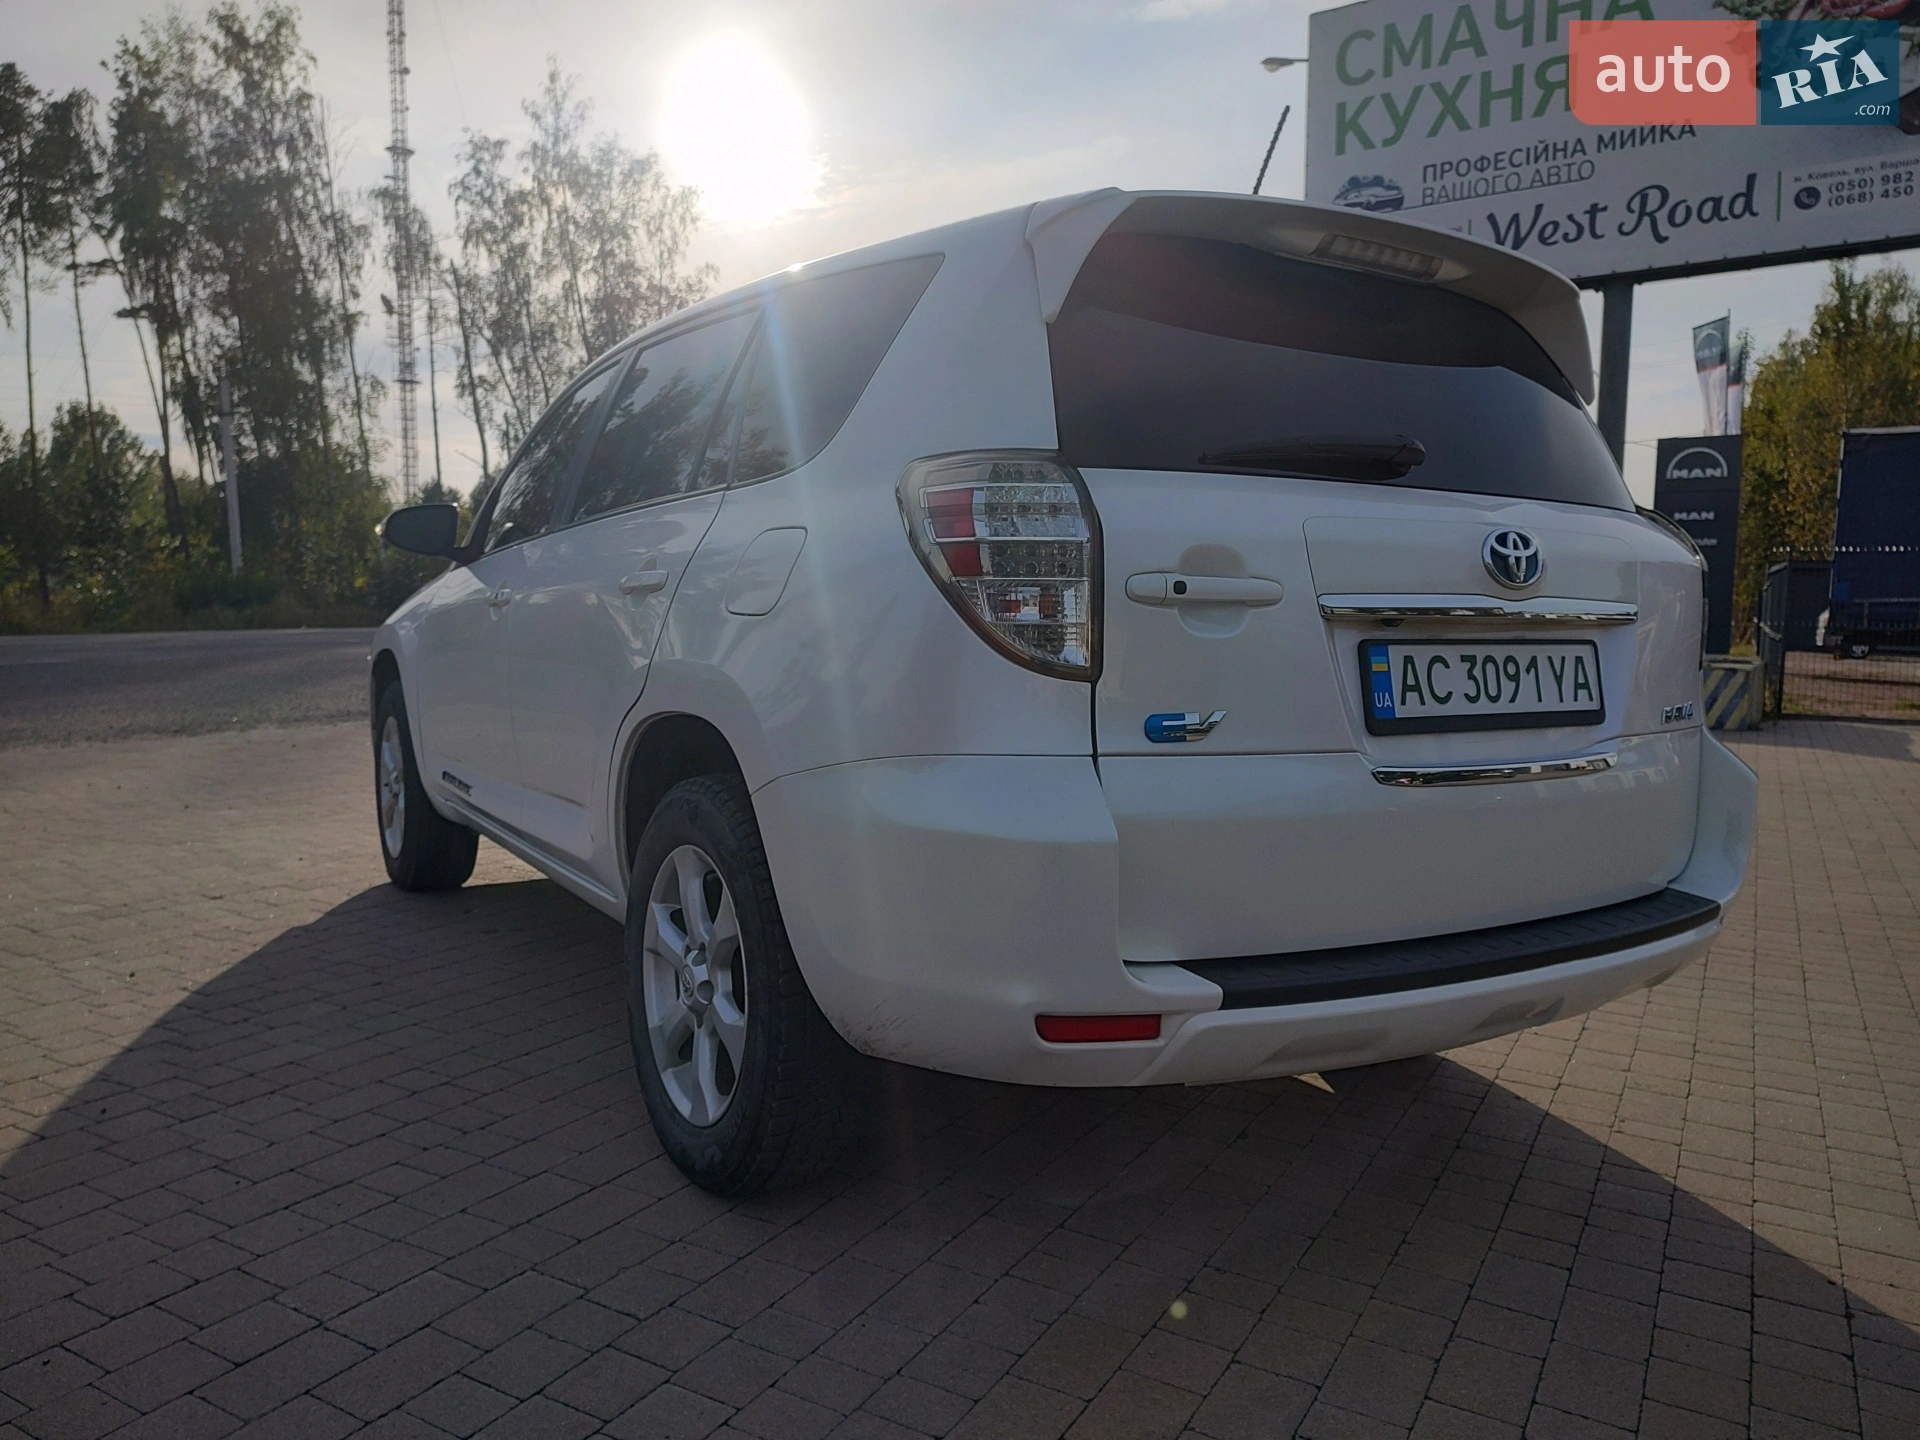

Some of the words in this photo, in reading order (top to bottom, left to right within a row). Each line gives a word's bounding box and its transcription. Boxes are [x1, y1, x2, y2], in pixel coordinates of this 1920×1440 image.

[1334, 53, 1578, 156] КУХНЯ
[1422, 137, 1587, 184] ПРОФЕСІЙНА
[1421, 171, 1522, 205] ВАШОГО
[1529, 159, 1596, 189] АВТО
[1828, 177, 1875, 195] (050)
[1881, 170, 1915, 186] 982
[1828, 191, 1875, 208] (068)
[1881, 184, 1915, 199] 450
[1486, 203, 1608, 250] West
[1617, 173, 1756, 244] Road
[1672, 468, 1722, 479] MAN
[1674, 511, 1715, 521] MAN
[1374, 692, 1392, 708] UA
